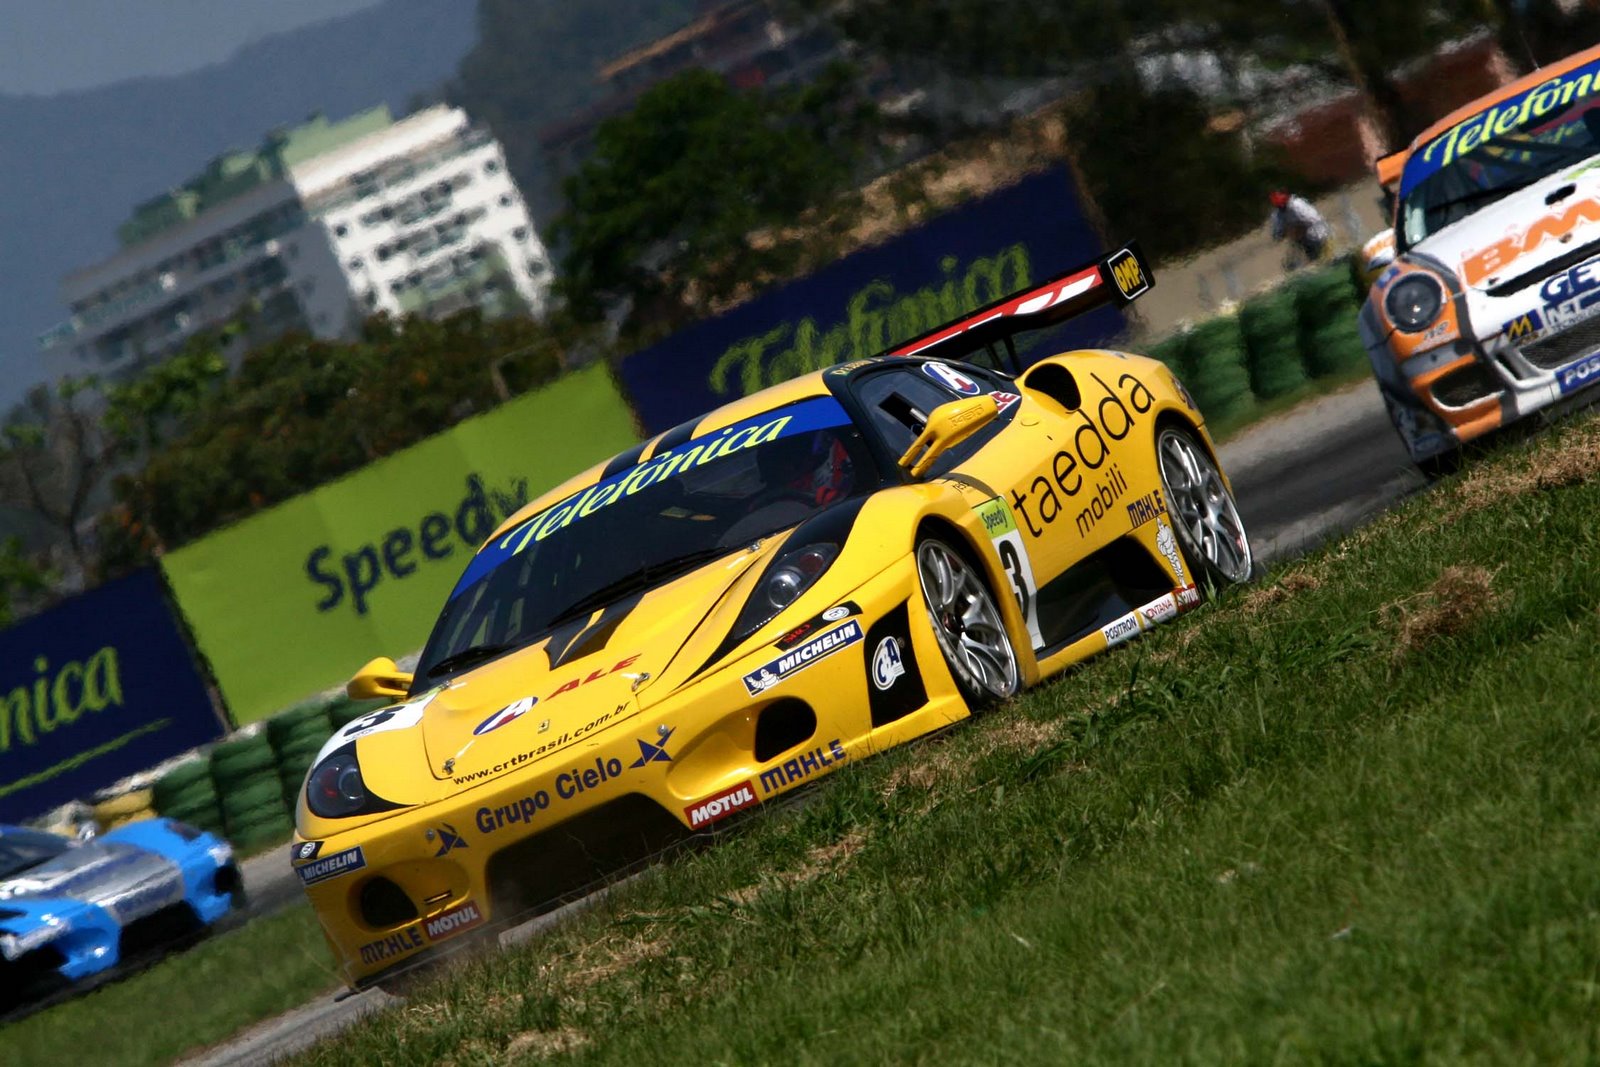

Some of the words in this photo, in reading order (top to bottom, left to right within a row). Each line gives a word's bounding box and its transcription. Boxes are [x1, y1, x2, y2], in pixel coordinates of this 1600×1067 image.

[1114, 257, 1140, 293] OMP
[1012, 372, 1157, 537] taedda
[981, 504, 1008, 534] Speedy
[1075, 463, 1128, 539] mobili
[1126, 489, 1165, 528] MAHLE
[999, 539, 1030, 624] 3
[779, 623, 856, 674] MICHELIN
[1105, 614, 1137, 643] POSITRON
[545, 653, 642, 701] ALE
[453, 701, 632, 786] www.crtbrasil.com.br
[760, 738, 848, 794] MAHLE
[475, 790, 550, 834] Grupo
[555, 757, 622, 800] Cielo
[691, 787, 754, 826] MOTUL
[304, 850, 358, 879] MICHELIN
[427, 906, 479, 937] MOTUL
